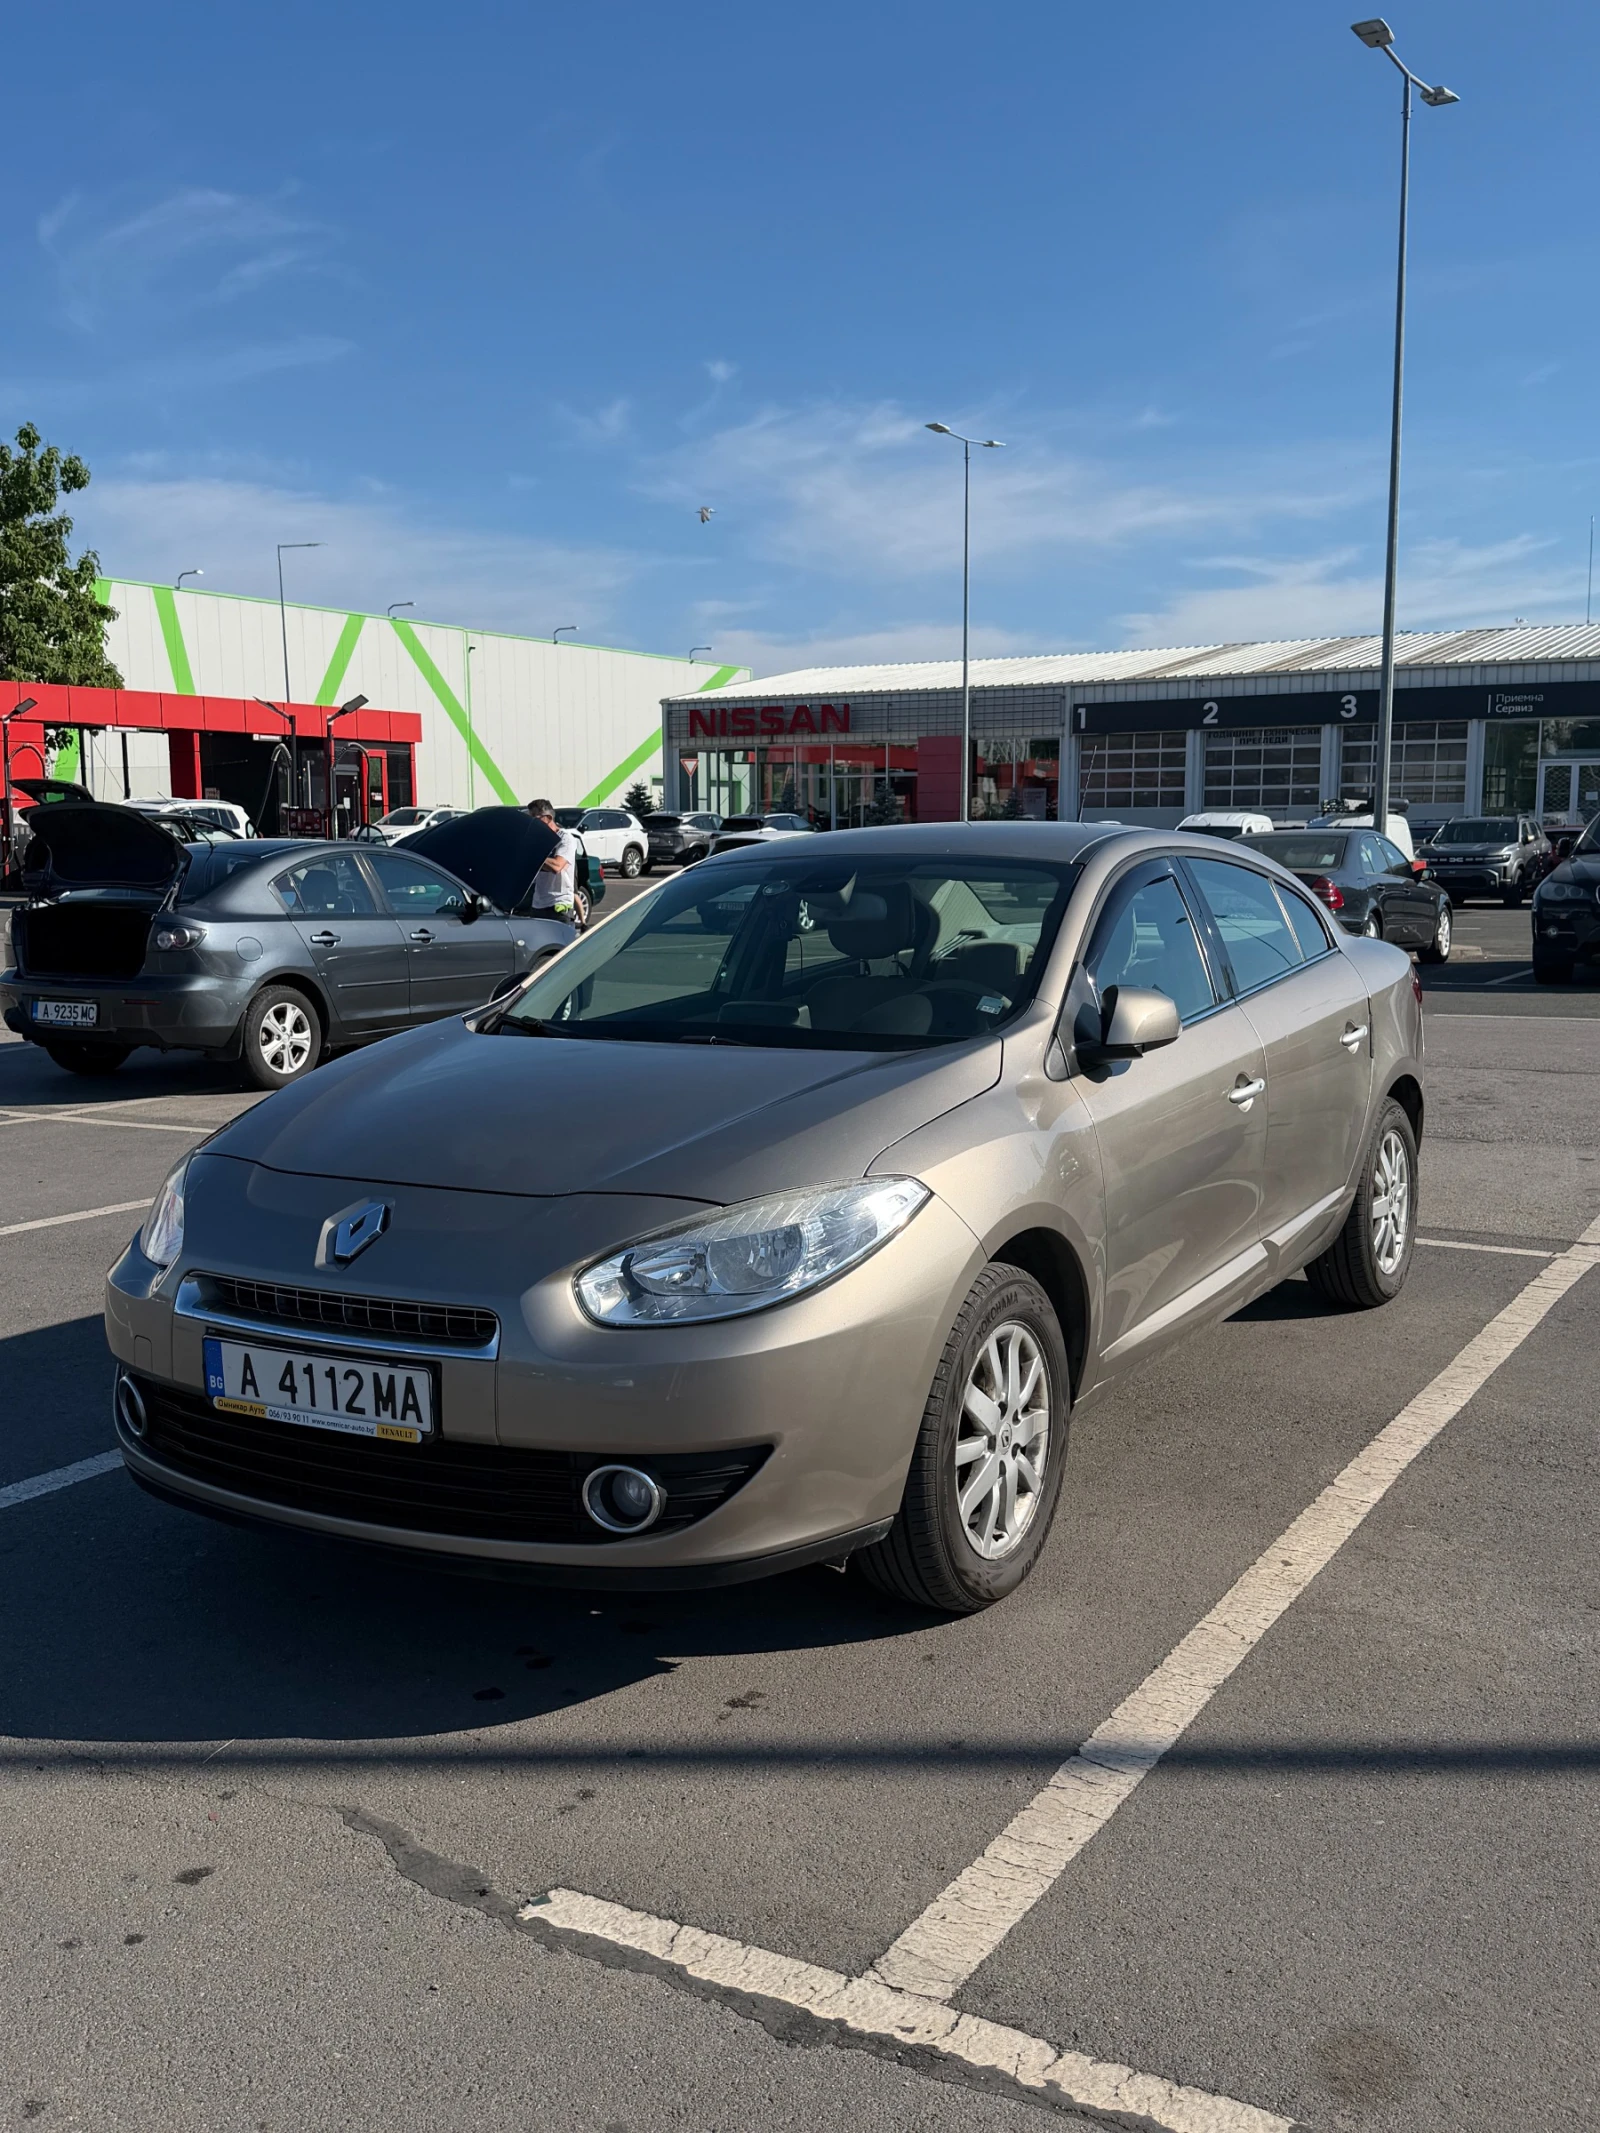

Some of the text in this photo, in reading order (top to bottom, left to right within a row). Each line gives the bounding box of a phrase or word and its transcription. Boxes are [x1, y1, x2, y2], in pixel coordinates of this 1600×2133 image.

[1340, 694, 1358, 719] 3
[1495, 704, 1534, 715] Сервиз
[1496, 693, 1544, 704] Приемна
[688, 703, 851, 738] NISSAN
[1077, 707, 1087, 729] 1
[1202, 701, 1219, 724] 2
[1207, 729, 1255, 739] ГОДИШНИ
[1239, 736, 1288, 745] ПРЕГЛЕДИ
[42, 1003, 95, 1021] A 9235 MC
[975, 1290, 1019, 1339] YOKOHAMA
[209, 1374, 223, 1390] BG
[240, 1352, 260, 1398] A
[218, 1399, 413, 1439] Омникар Ауто 056/93 90 11 www.omnicar-auto.bg RENAULT
